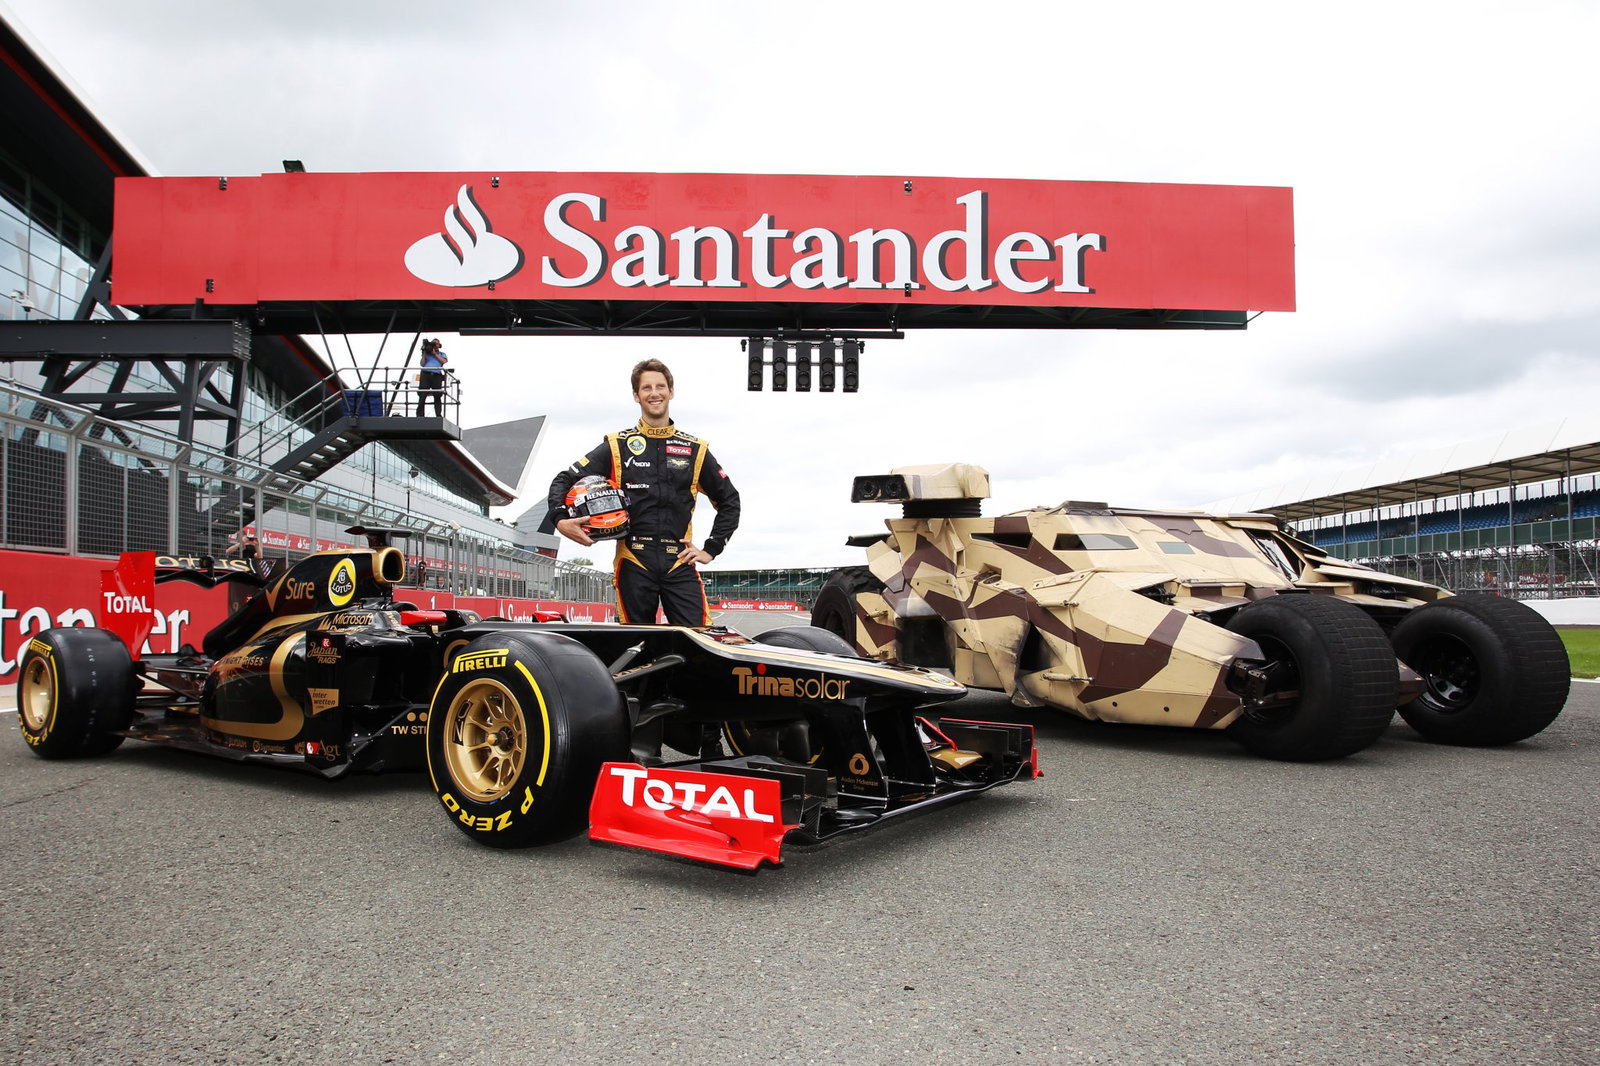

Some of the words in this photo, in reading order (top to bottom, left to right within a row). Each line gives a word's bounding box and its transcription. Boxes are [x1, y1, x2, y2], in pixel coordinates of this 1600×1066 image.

[541, 190, 1105, 293] Santander
[667, 446, 690, 455] TOTAL
[587, 489, 618, 500] RENAULT
[285, 578, 315, 600] Sure
[331, 582, 352, 594] LOTUS
[104, 591, 151, 614] TOTAL
[765, 602, 793, 610] Santander
[332, 613, 373, 626] Microsoft
[307, 641, 338, 658] Japan
[317, 656, 337, 665] RAGS
[453, 649, 509, 673] PIRELLI
[732, 665, 850, 700] Trinasolar
[391, 725, 409, 735] TW
[520, 786, 534, 815] P
[610, 767, 774, 823] TOTAL
[442, 792, 513, 831] ZERO
